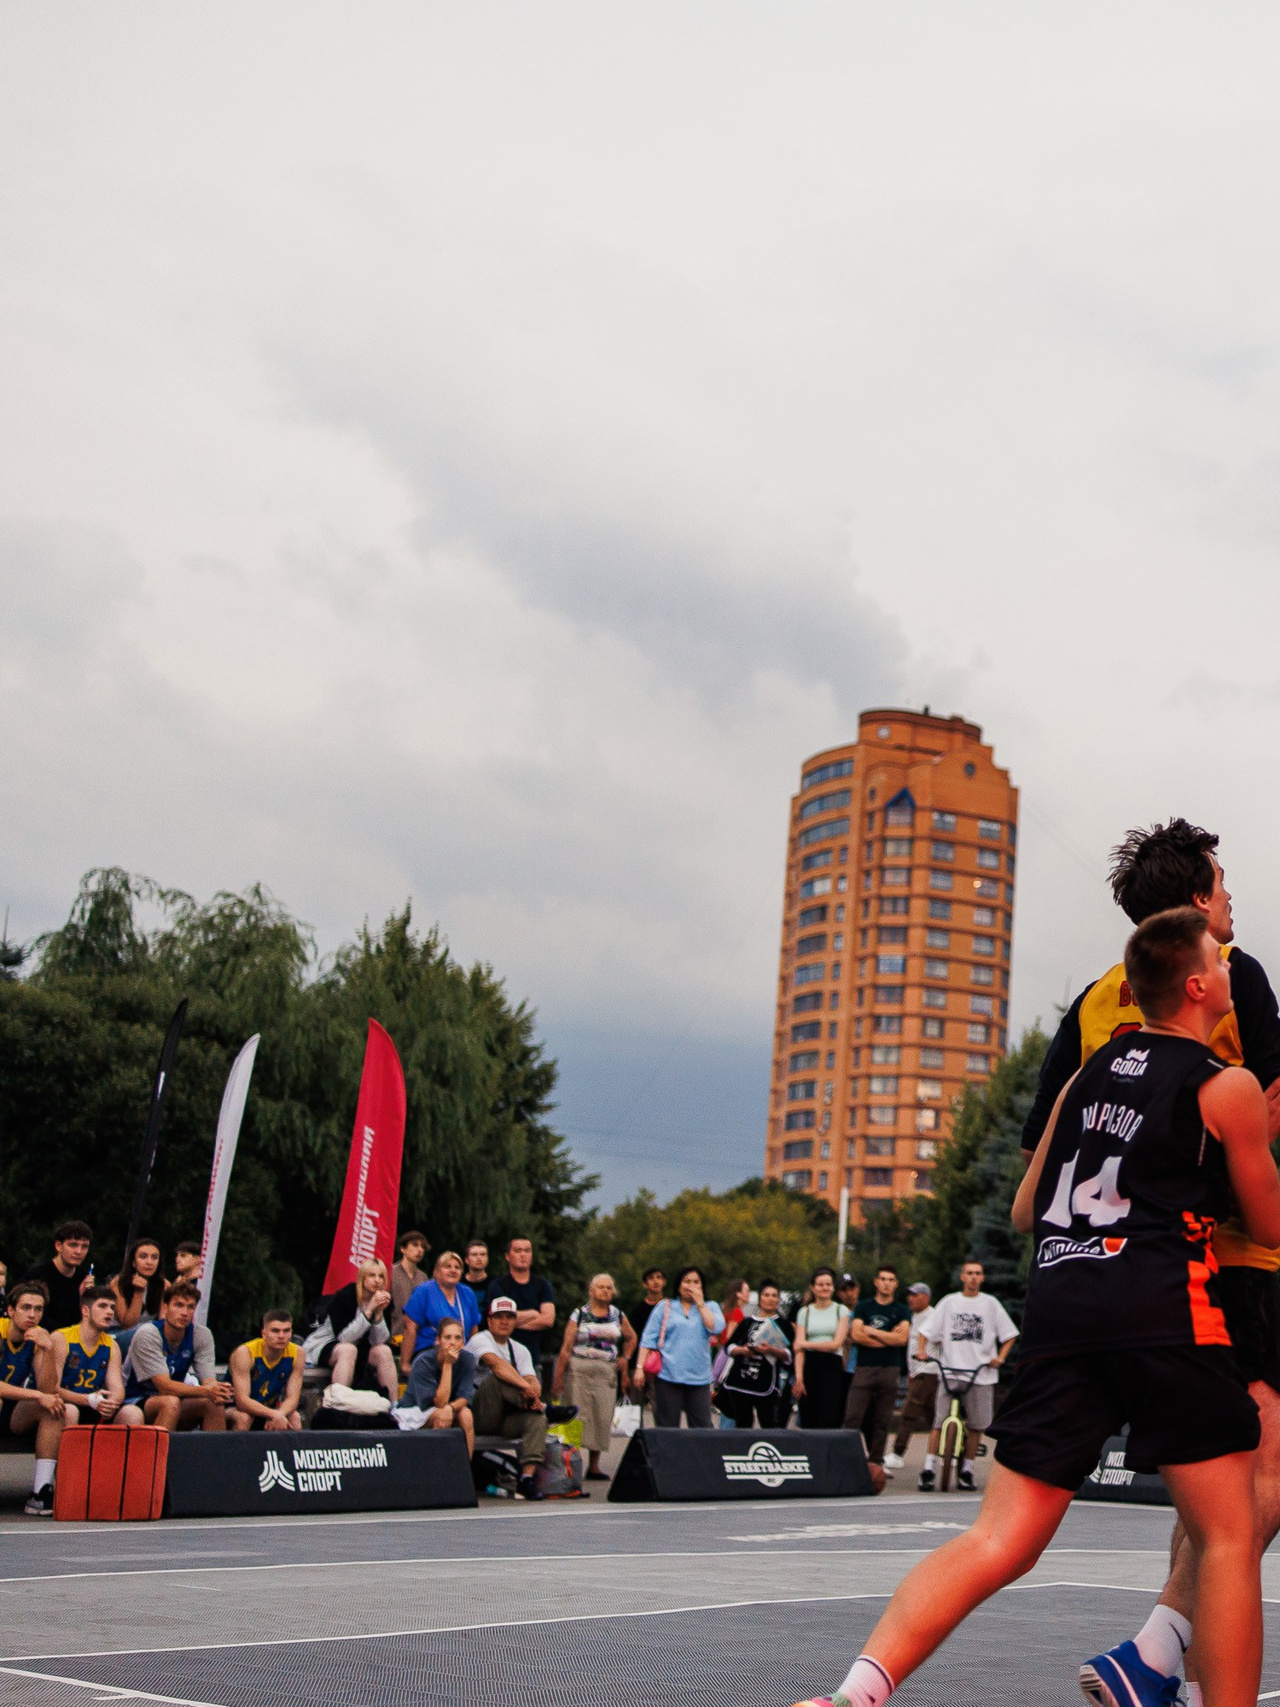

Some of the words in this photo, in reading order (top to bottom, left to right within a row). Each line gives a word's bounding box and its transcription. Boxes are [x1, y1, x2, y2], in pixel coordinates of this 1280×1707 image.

[1041, 1148, 1132, 1229] 14
[293, 1443, 388, 1471] МОСКОВСКИЙ
[723, 1461, 811, 1474] STREETBASKET
[297, 1471, 342, 1493] СПОРТ
